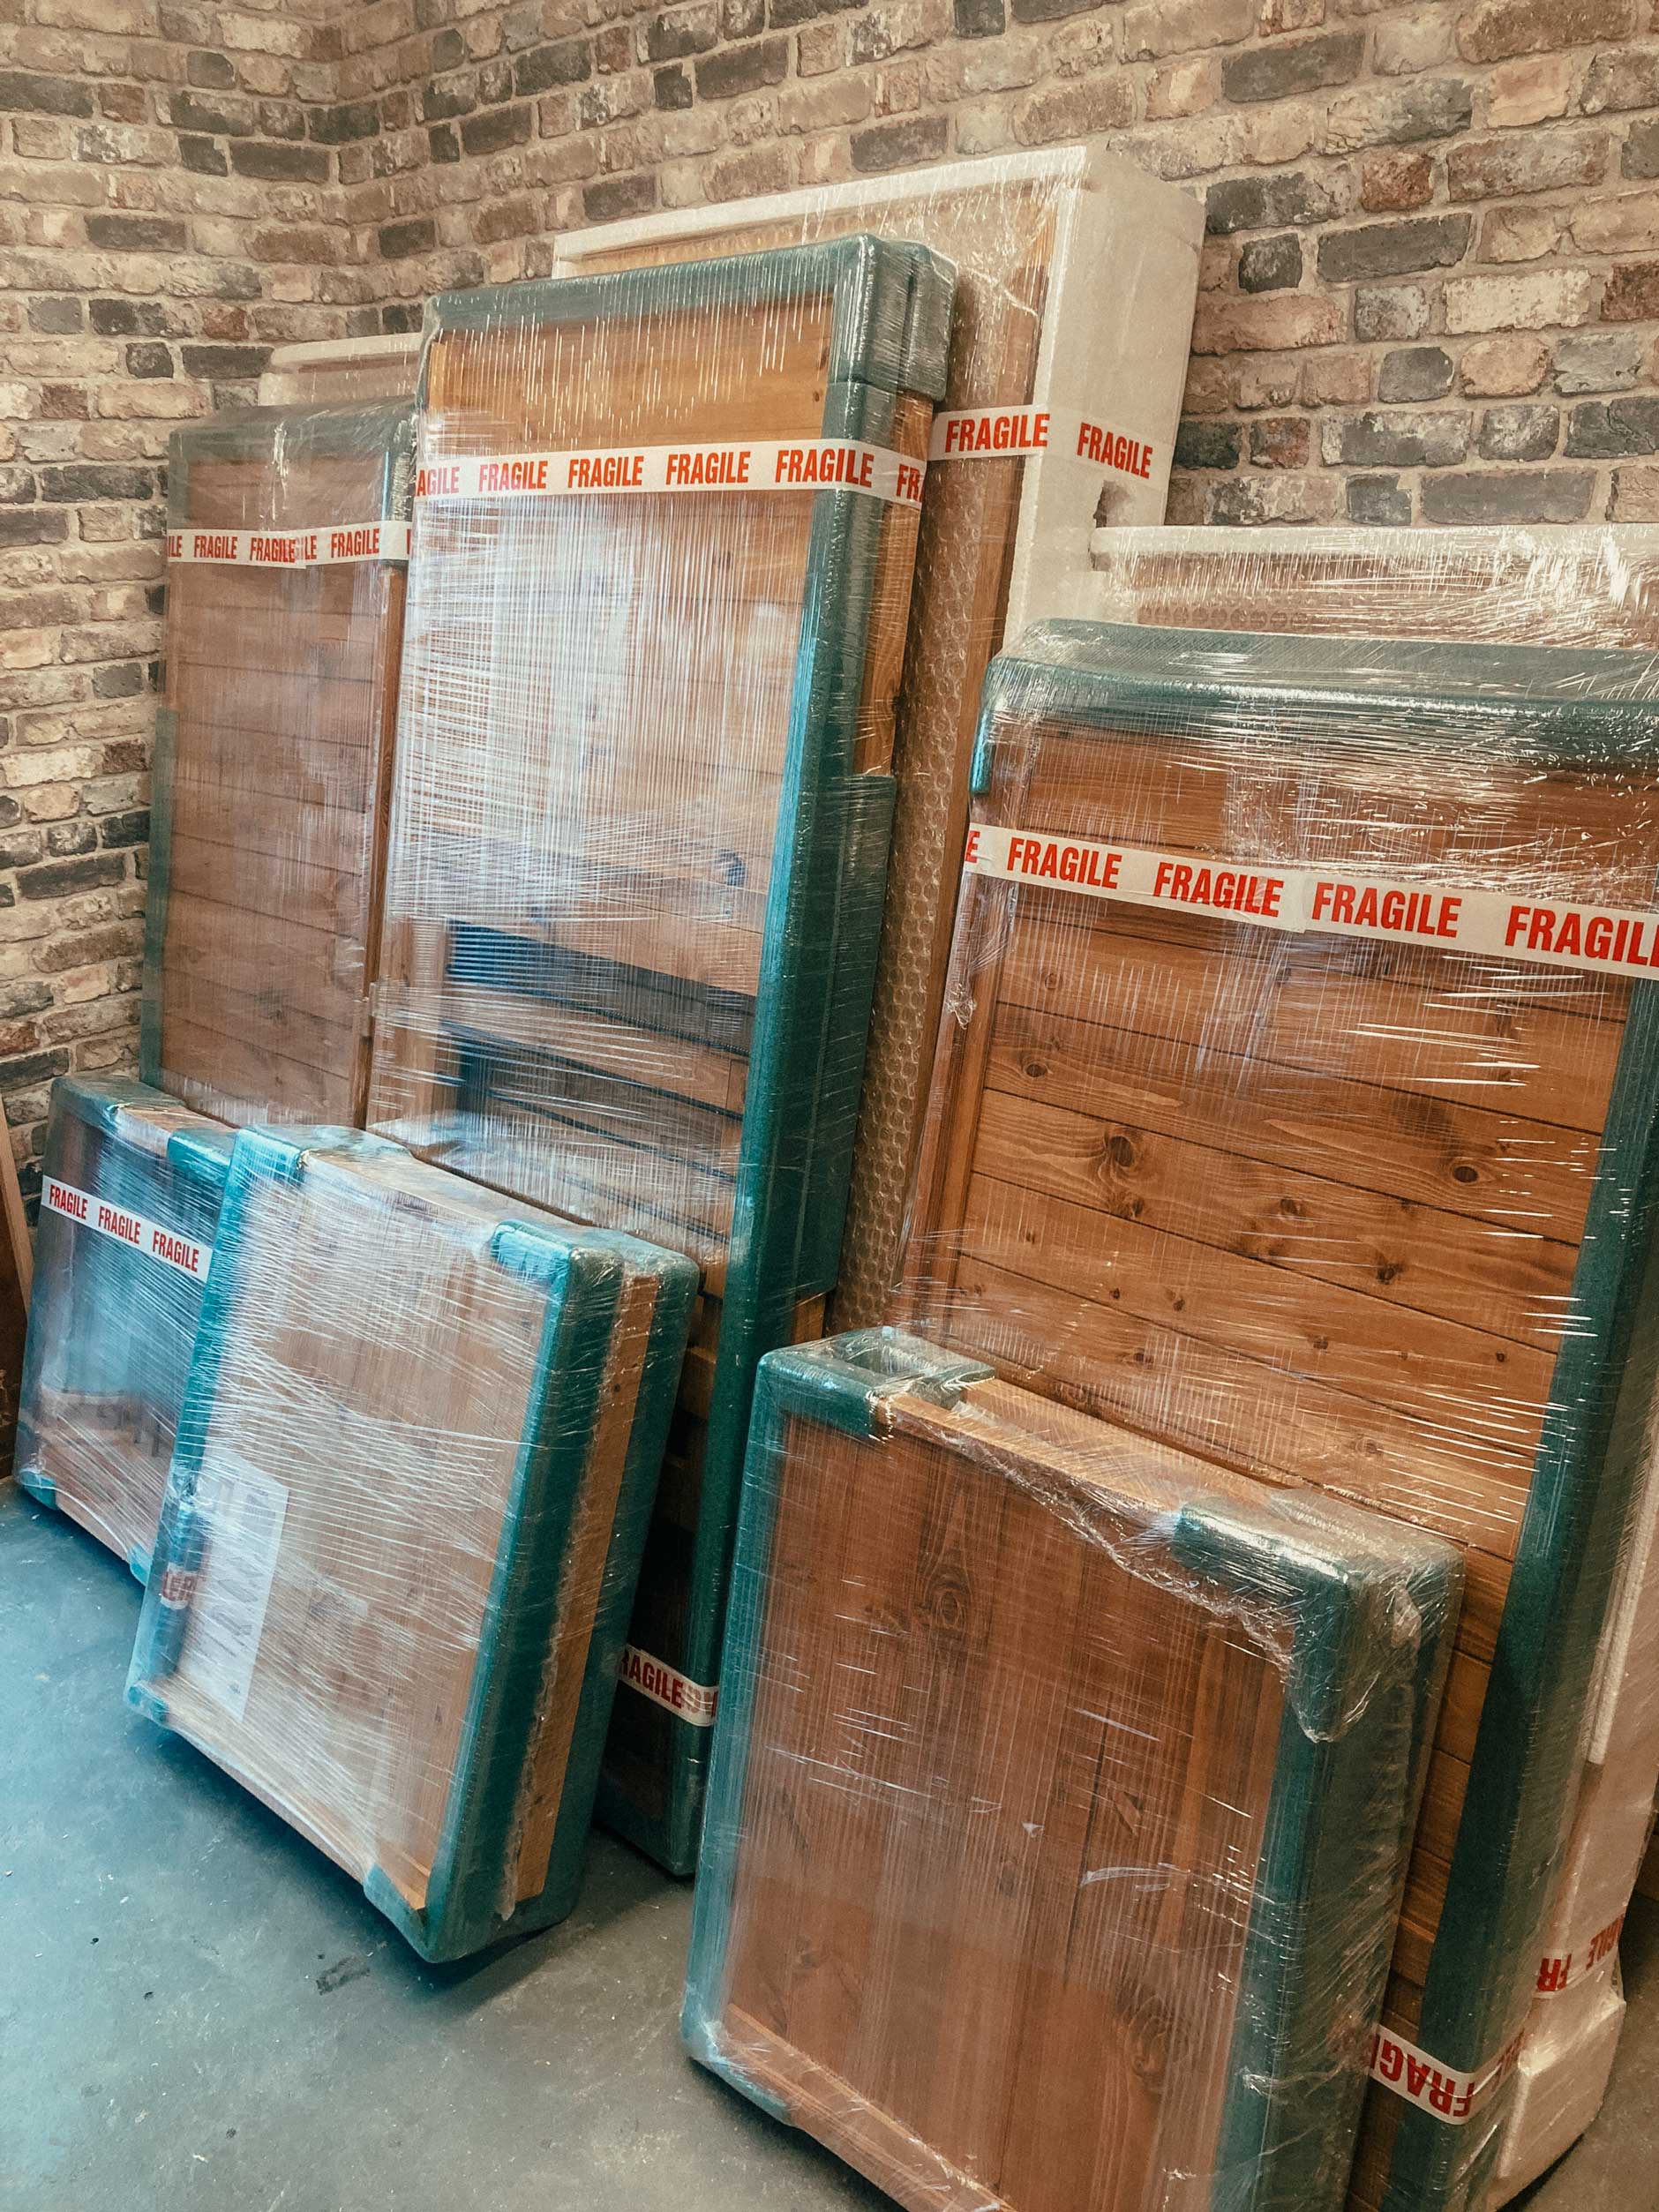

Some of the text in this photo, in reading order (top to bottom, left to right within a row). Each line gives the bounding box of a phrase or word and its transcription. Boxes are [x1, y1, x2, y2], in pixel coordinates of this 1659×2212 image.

[415, 466, 460, 497] AGILE
[479, 460, 549, 491] FRAGILE
[567, 455, 645, 489] FRAGILE
[664, 450, 751, 485] FRAGILE
[774, 447, 875, 488] FRAGILE
[944, 413, 1154, 479] FRAGILE FRAGILE
[193, 535, 238, 559] FRAGILE
[249, 536, 297, 564] FRAGILE
[330, 528, 380, 559] FRAGILE
[1006, 836, 1123, 890] FRAGILE
[1152, 861, 1285, 919] FRAGILE
[1310, 881, 1463, 939] FRAGILE
[1504, 904, 1659, 968] FRAGIL
[49, 1184, 200, 1272] FRAGILE FRAGILE FRAGILE
[1370, 2033, 1475, 2118] FRAGI
